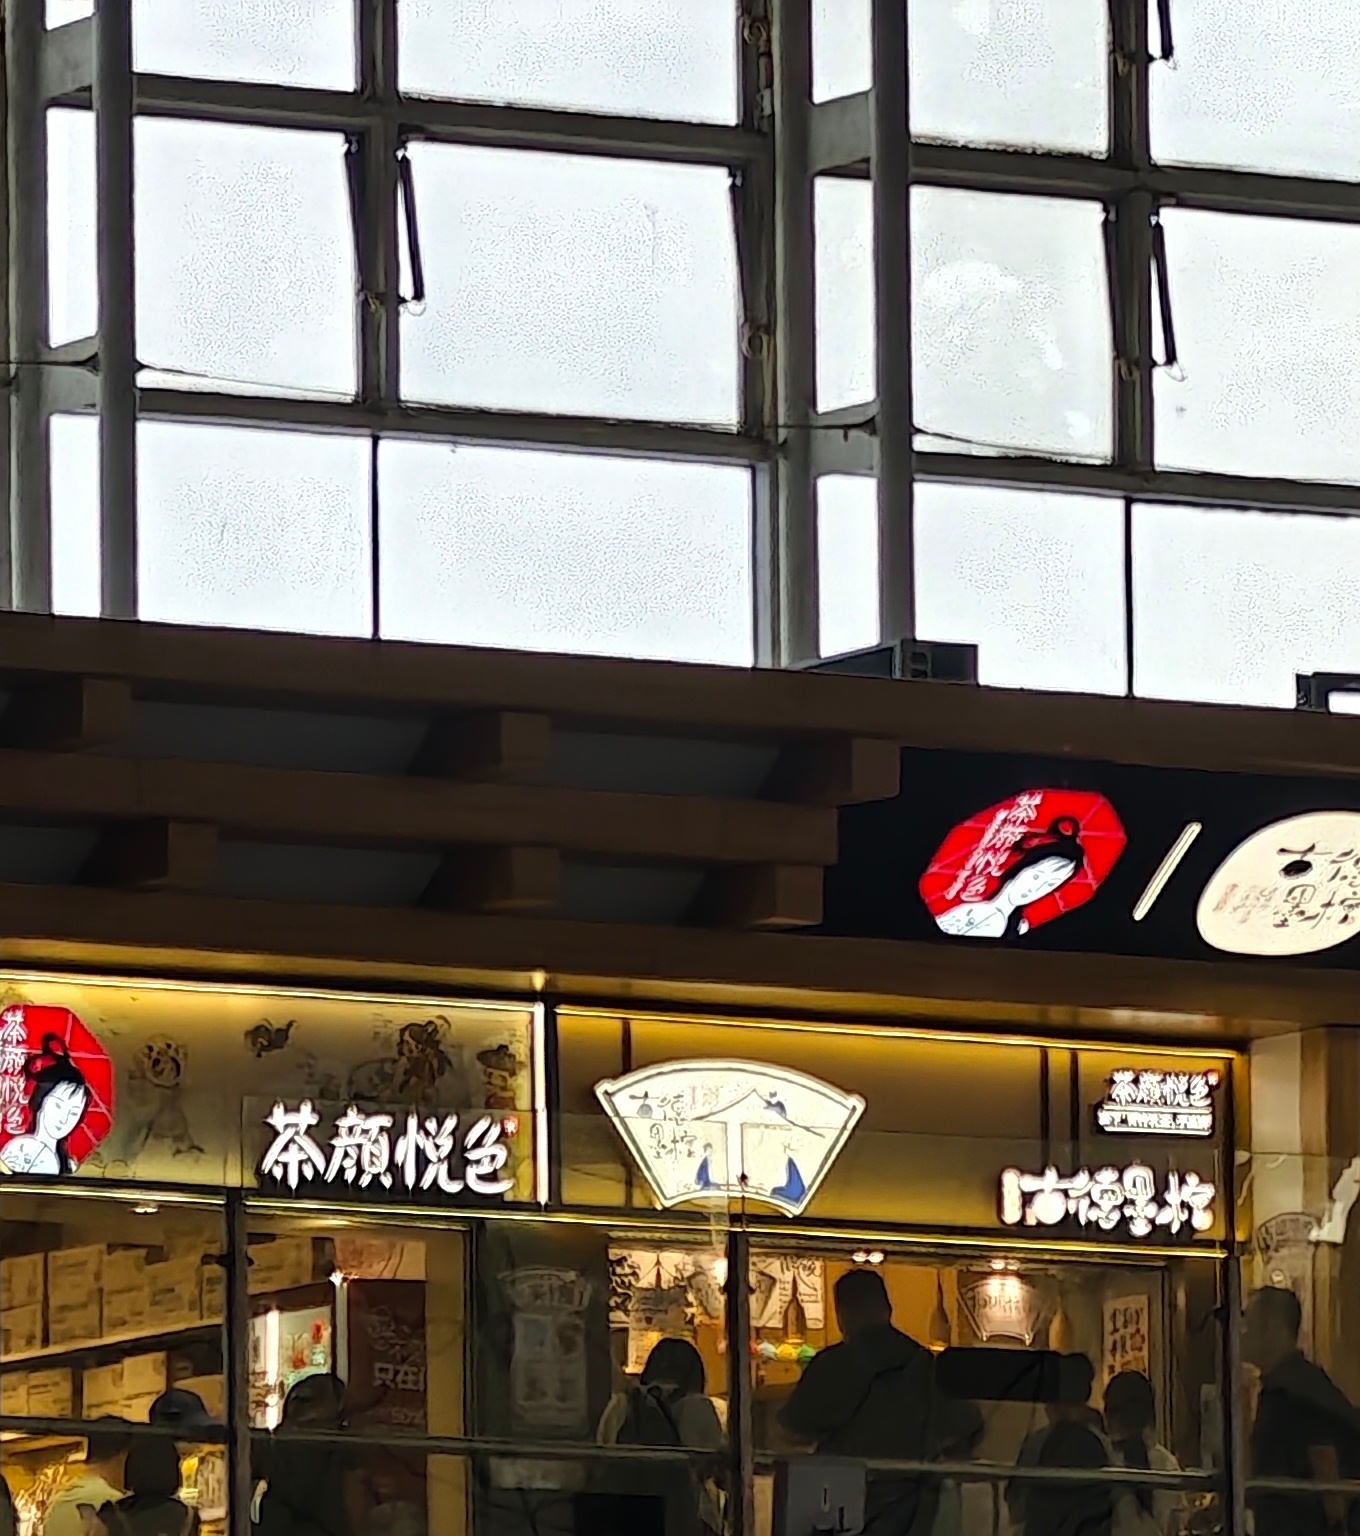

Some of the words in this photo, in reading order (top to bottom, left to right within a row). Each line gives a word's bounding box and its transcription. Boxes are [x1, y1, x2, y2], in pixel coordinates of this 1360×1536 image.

[2, 1008, 29, 1135] 茶颜悦色
[261, 1100, 515, 1195] 茶颜悦色
